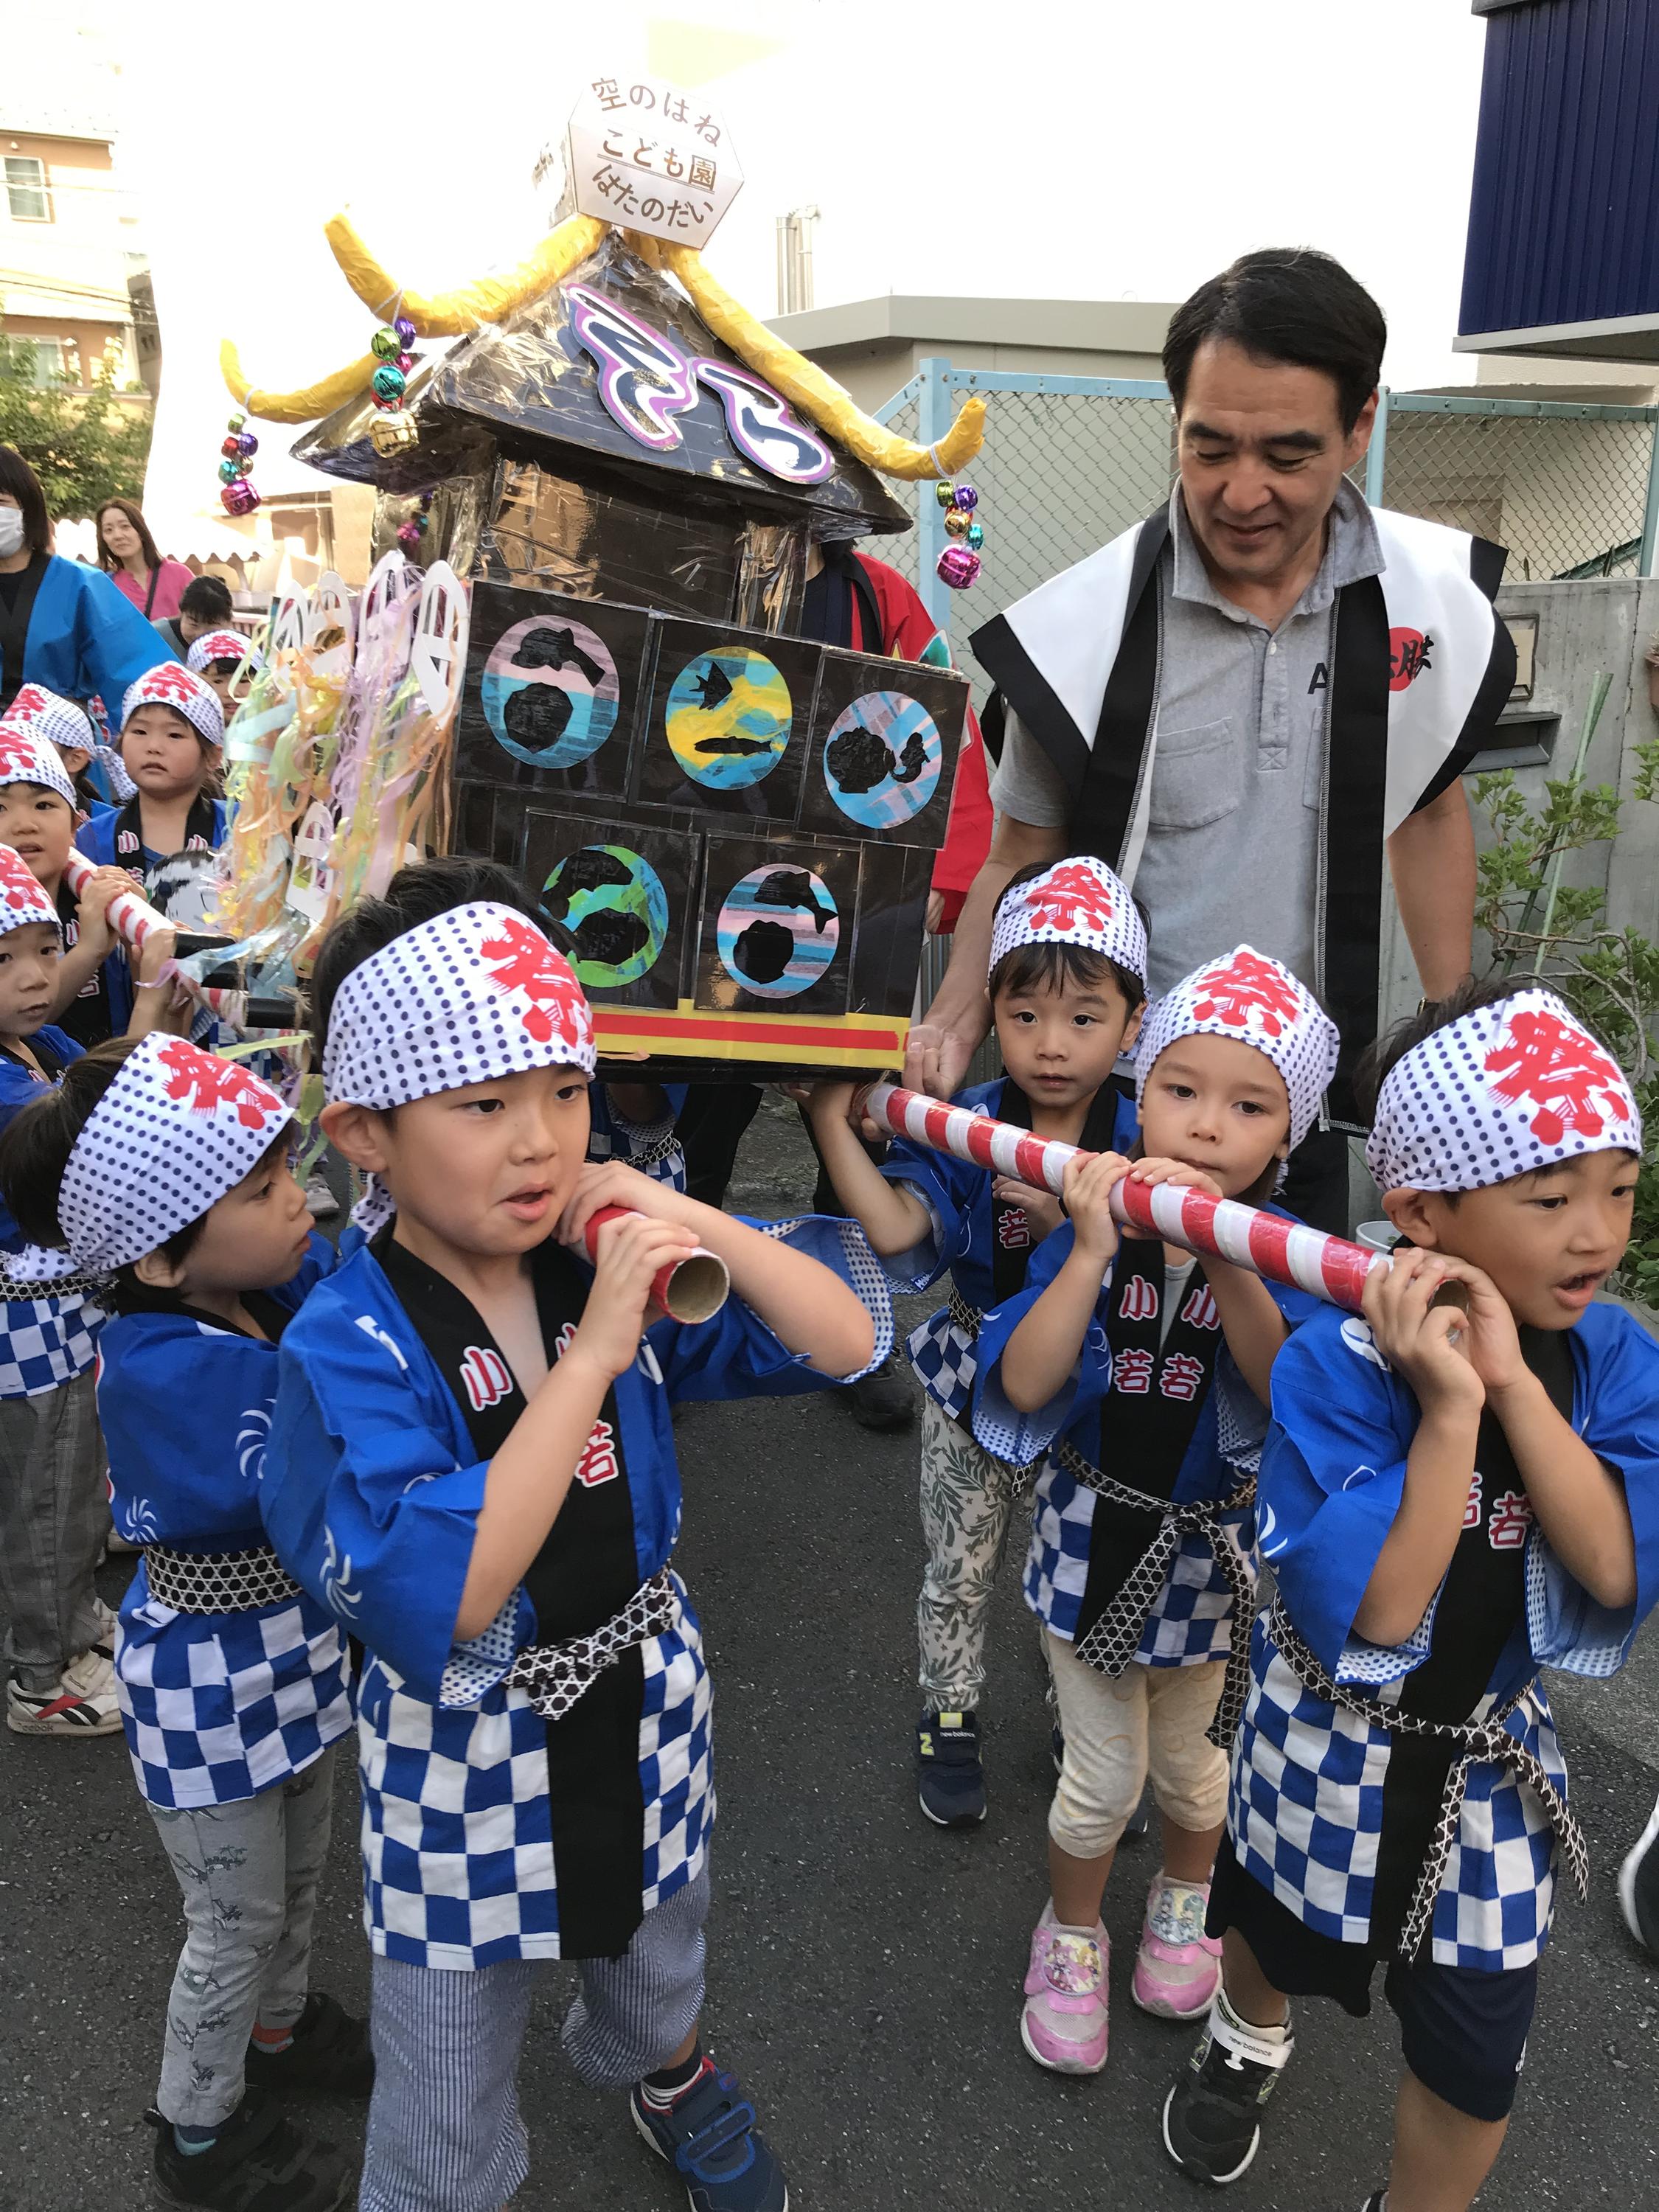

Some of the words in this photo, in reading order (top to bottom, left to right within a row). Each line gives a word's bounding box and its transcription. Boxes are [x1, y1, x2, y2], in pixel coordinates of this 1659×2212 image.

[591, 77, 721, 147] 空のはね
[602, 128, 717, 190] こども園
[592, 164, 714, 228] はたのだい
[1024, 864, 1119, 932] 祭
[1192, 952, 1303, 1037] 祭
[1483, 1010, 1630, 1146] 祭
[1243, 2042, 1273, 2057] balance
